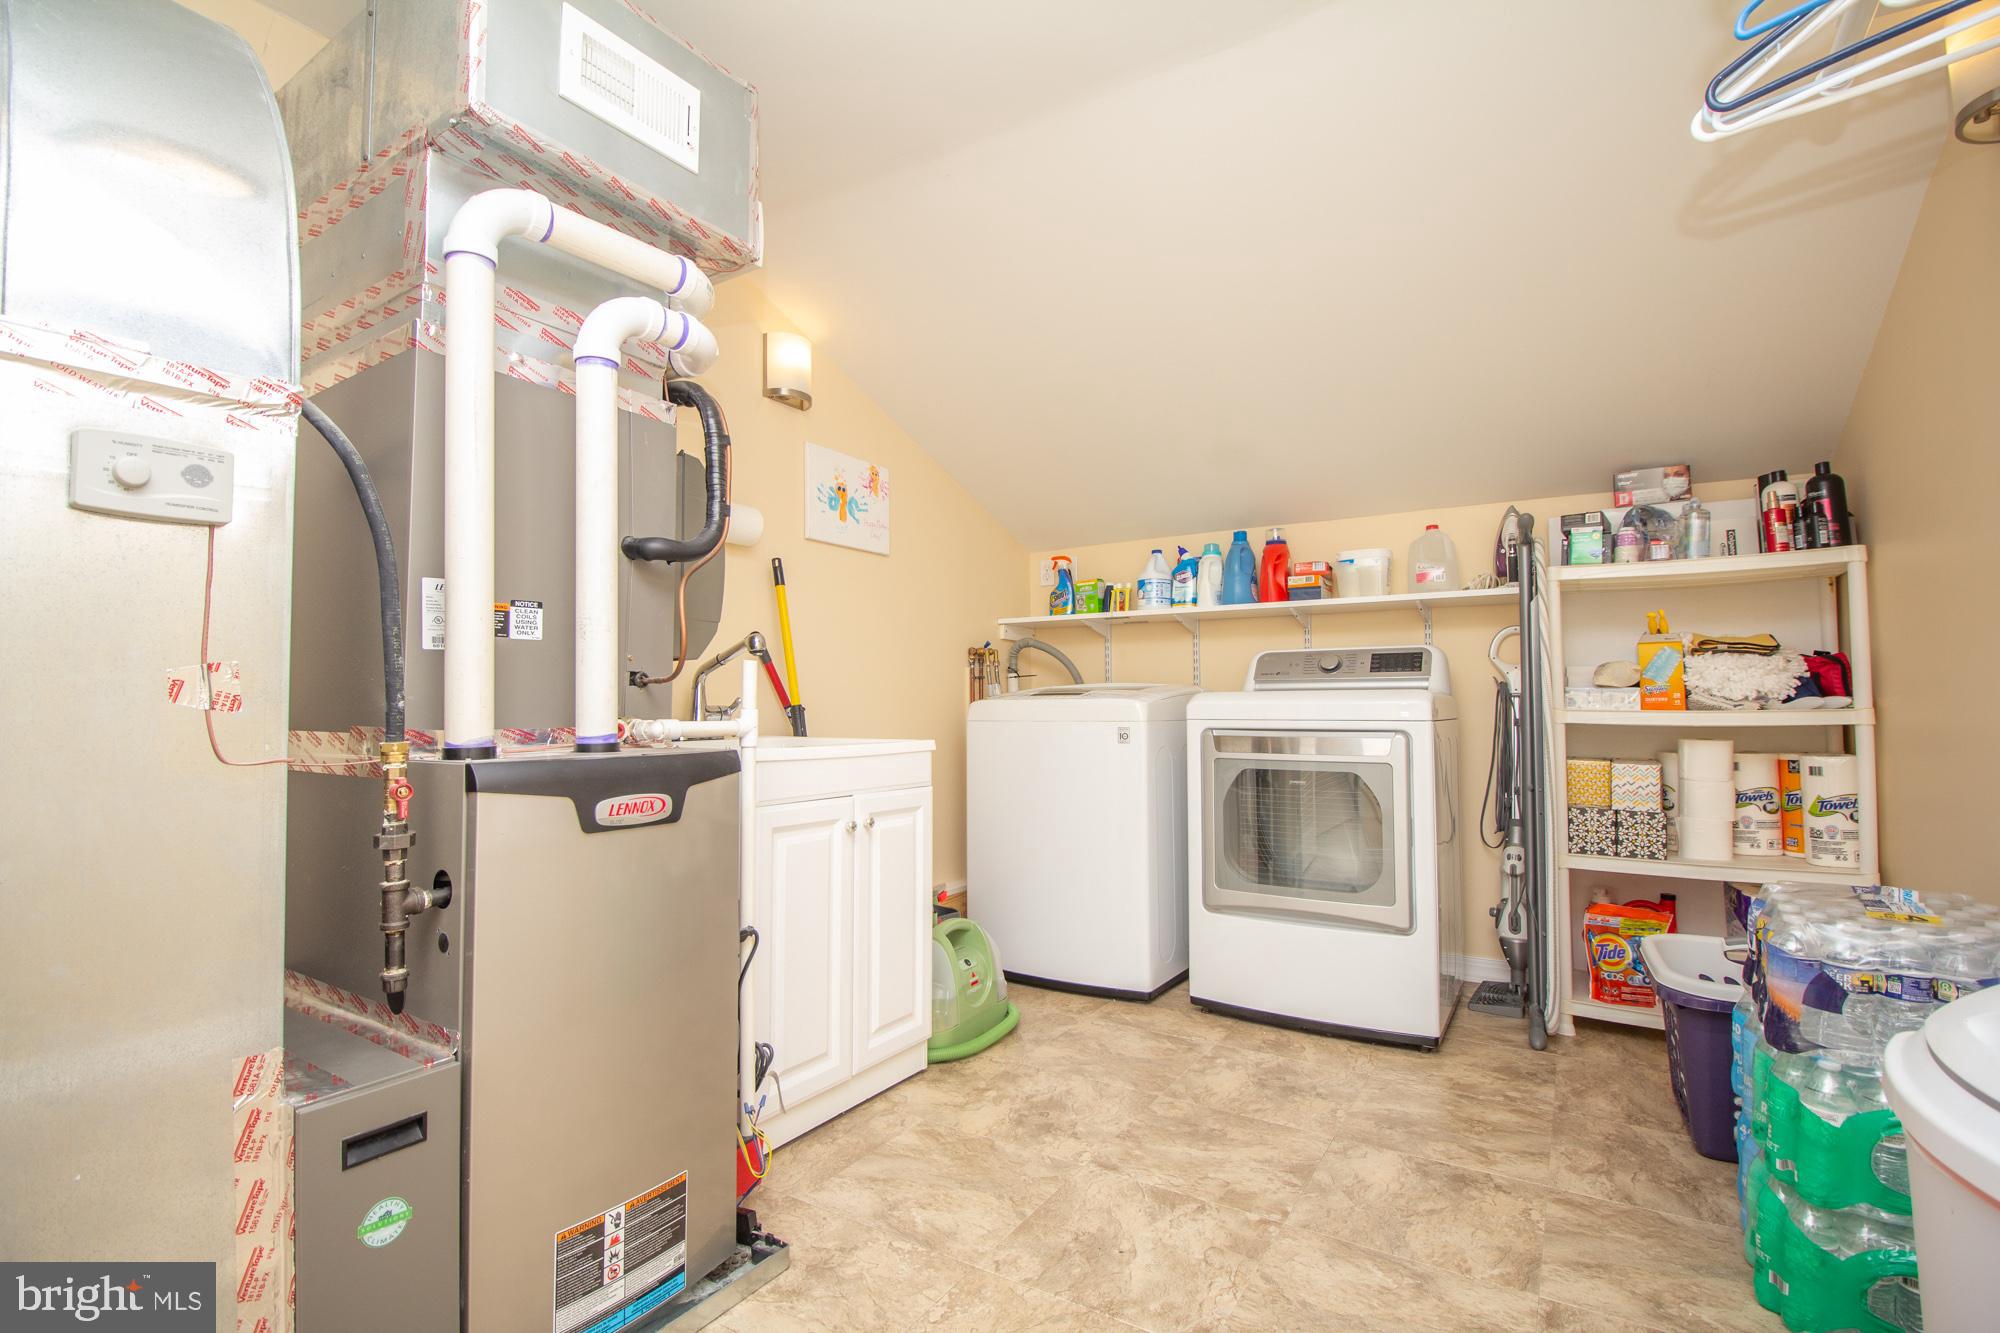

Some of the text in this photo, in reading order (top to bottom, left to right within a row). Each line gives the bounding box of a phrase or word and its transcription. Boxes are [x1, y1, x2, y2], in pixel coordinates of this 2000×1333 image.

[1735, 791, 1774, 804] Towels
[1785, 793, 1802, 807] To
[1817, 798, 1858, 812] Towel
[608, 800, 656, 817] LENNOX
[1595, 943, 1626, 962] Tide
[567, 1217, 602, 1238] WARNING
